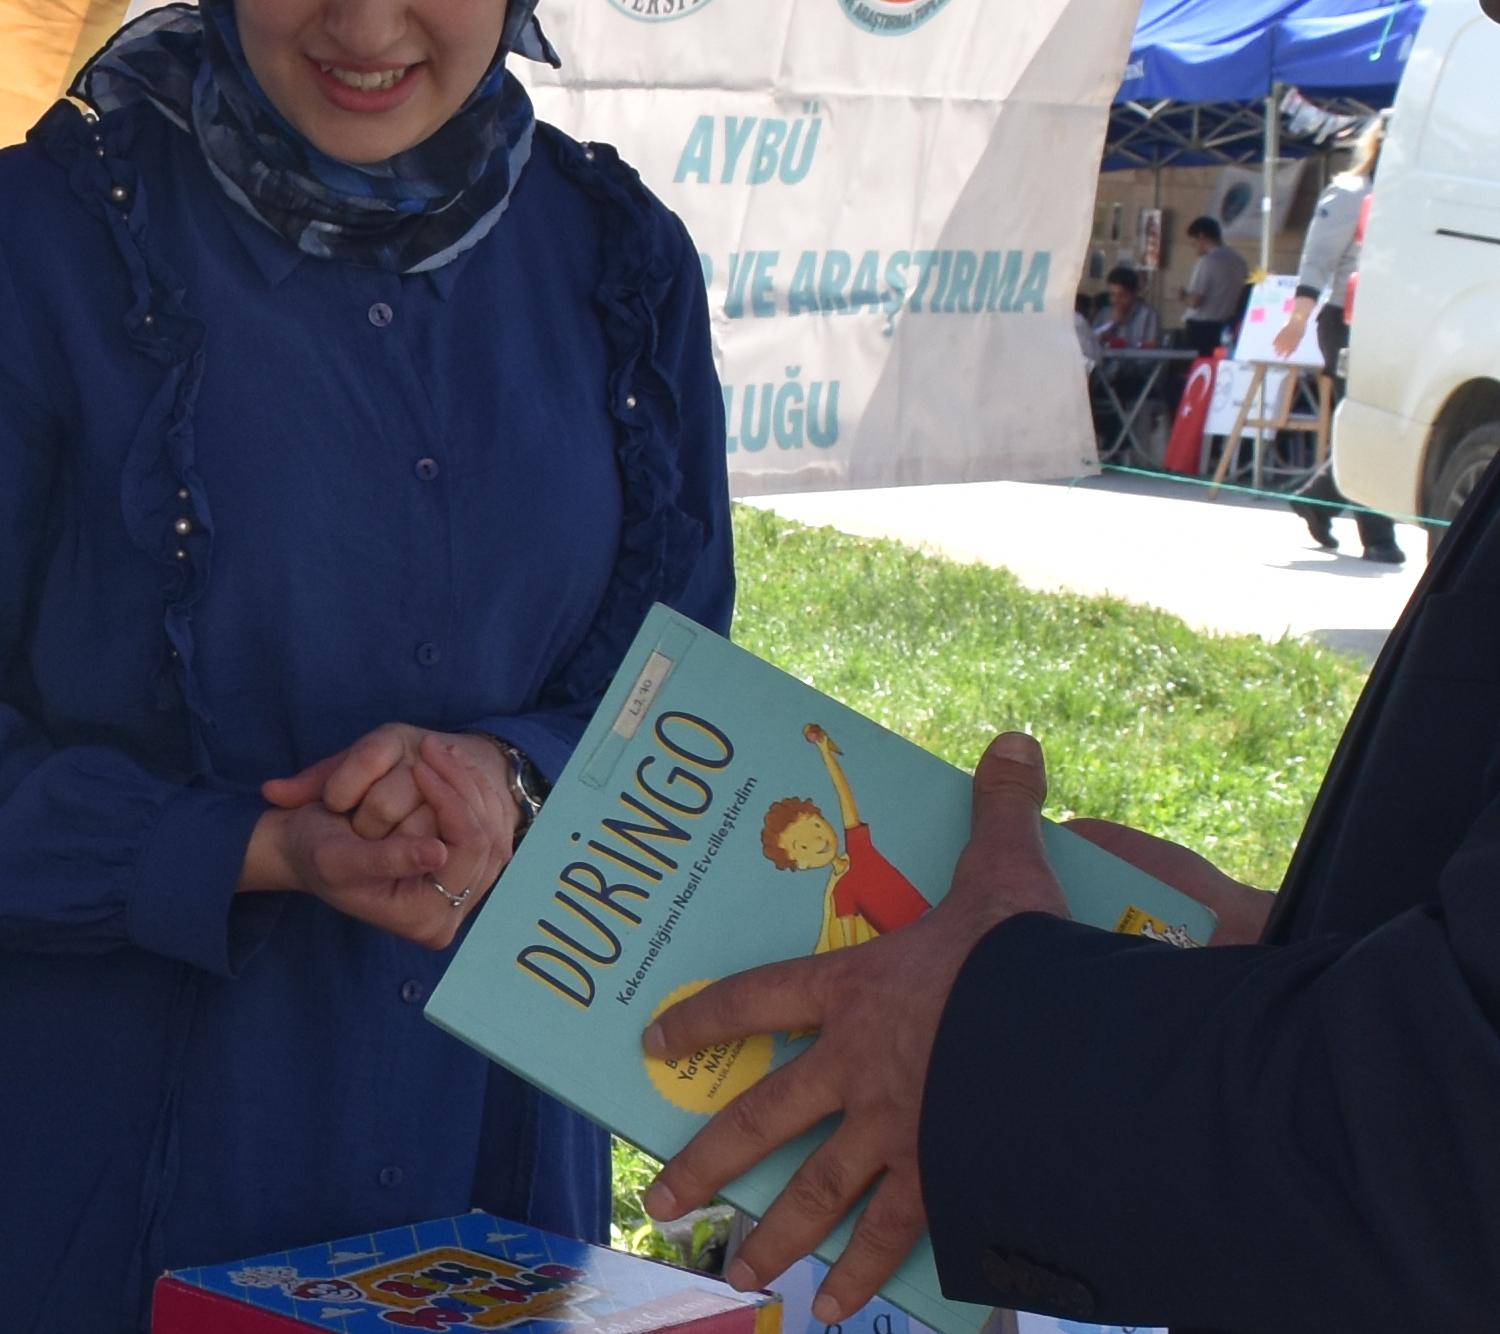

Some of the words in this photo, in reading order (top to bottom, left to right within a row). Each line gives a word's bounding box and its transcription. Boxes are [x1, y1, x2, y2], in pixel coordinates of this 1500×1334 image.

[673, 102, 822, 186] AYBÜ
[724, 250, 780, 319] VE
[788, 250, 1053, 338] ARAŞTIRMA
[615, 906, 682, 1006] Kekemeliğimi
[673, 870, 703, 910] Nasıl
[692, 776, 758, 875] Evcilleştirdim
